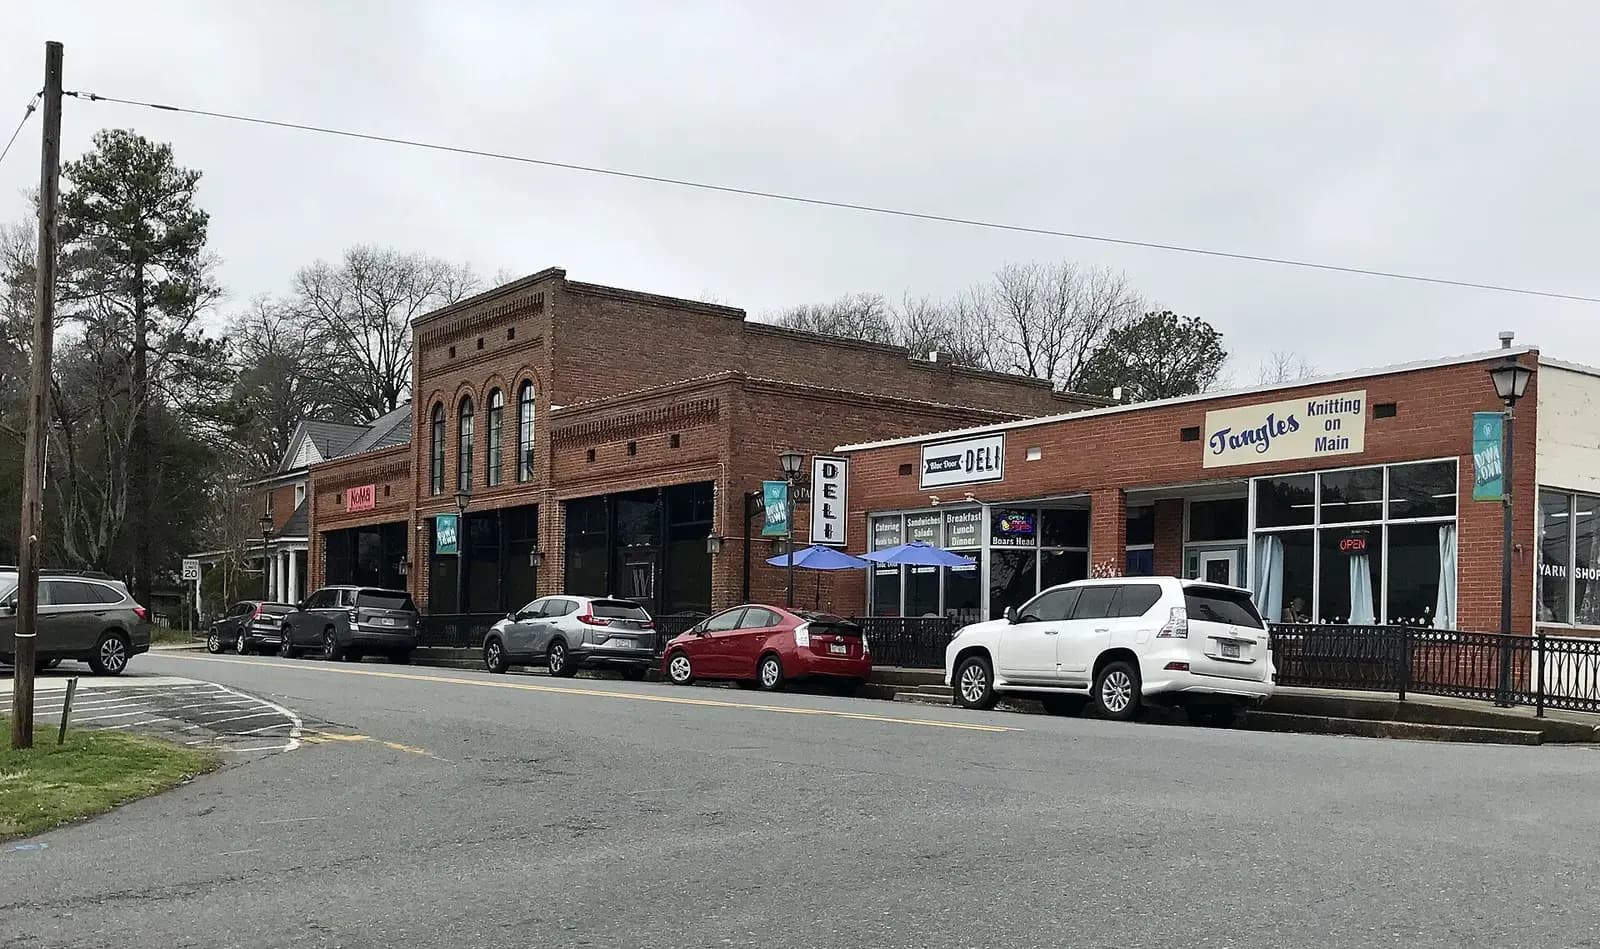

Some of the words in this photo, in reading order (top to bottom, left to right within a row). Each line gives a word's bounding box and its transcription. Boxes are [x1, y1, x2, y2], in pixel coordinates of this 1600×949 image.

[1307, 398, 1361, 417] Knitting
[1324, 419, 1341, 431] on
[1210, 413, 1300, 455] Tangles
[1315, 435, 1349, 452] Main
[943, 460, 957, 469] Door
[965, 445, 1001, 474] DELI
[822, 462, 839, 539] DELI
[907, 516, 941, 527] Sandwiches
[946, 511, 982, 523] Breakfast
[875, 522, 900, 532] Catering
[953, 524, 975, 534] Lunch
[914, 528, 933, 538] Salads
[951, 537, 976, 546] Dinner
[992, 536, 1015, 545] Boars
[1016, 536, 1035, 546] Head
[1340, 539, 1366, 550] OPEN
[184, 569, 198, 578] 20
[1538, 564, 1567, 577] YARN
[1575, 567, 1600, 580] SHOP
